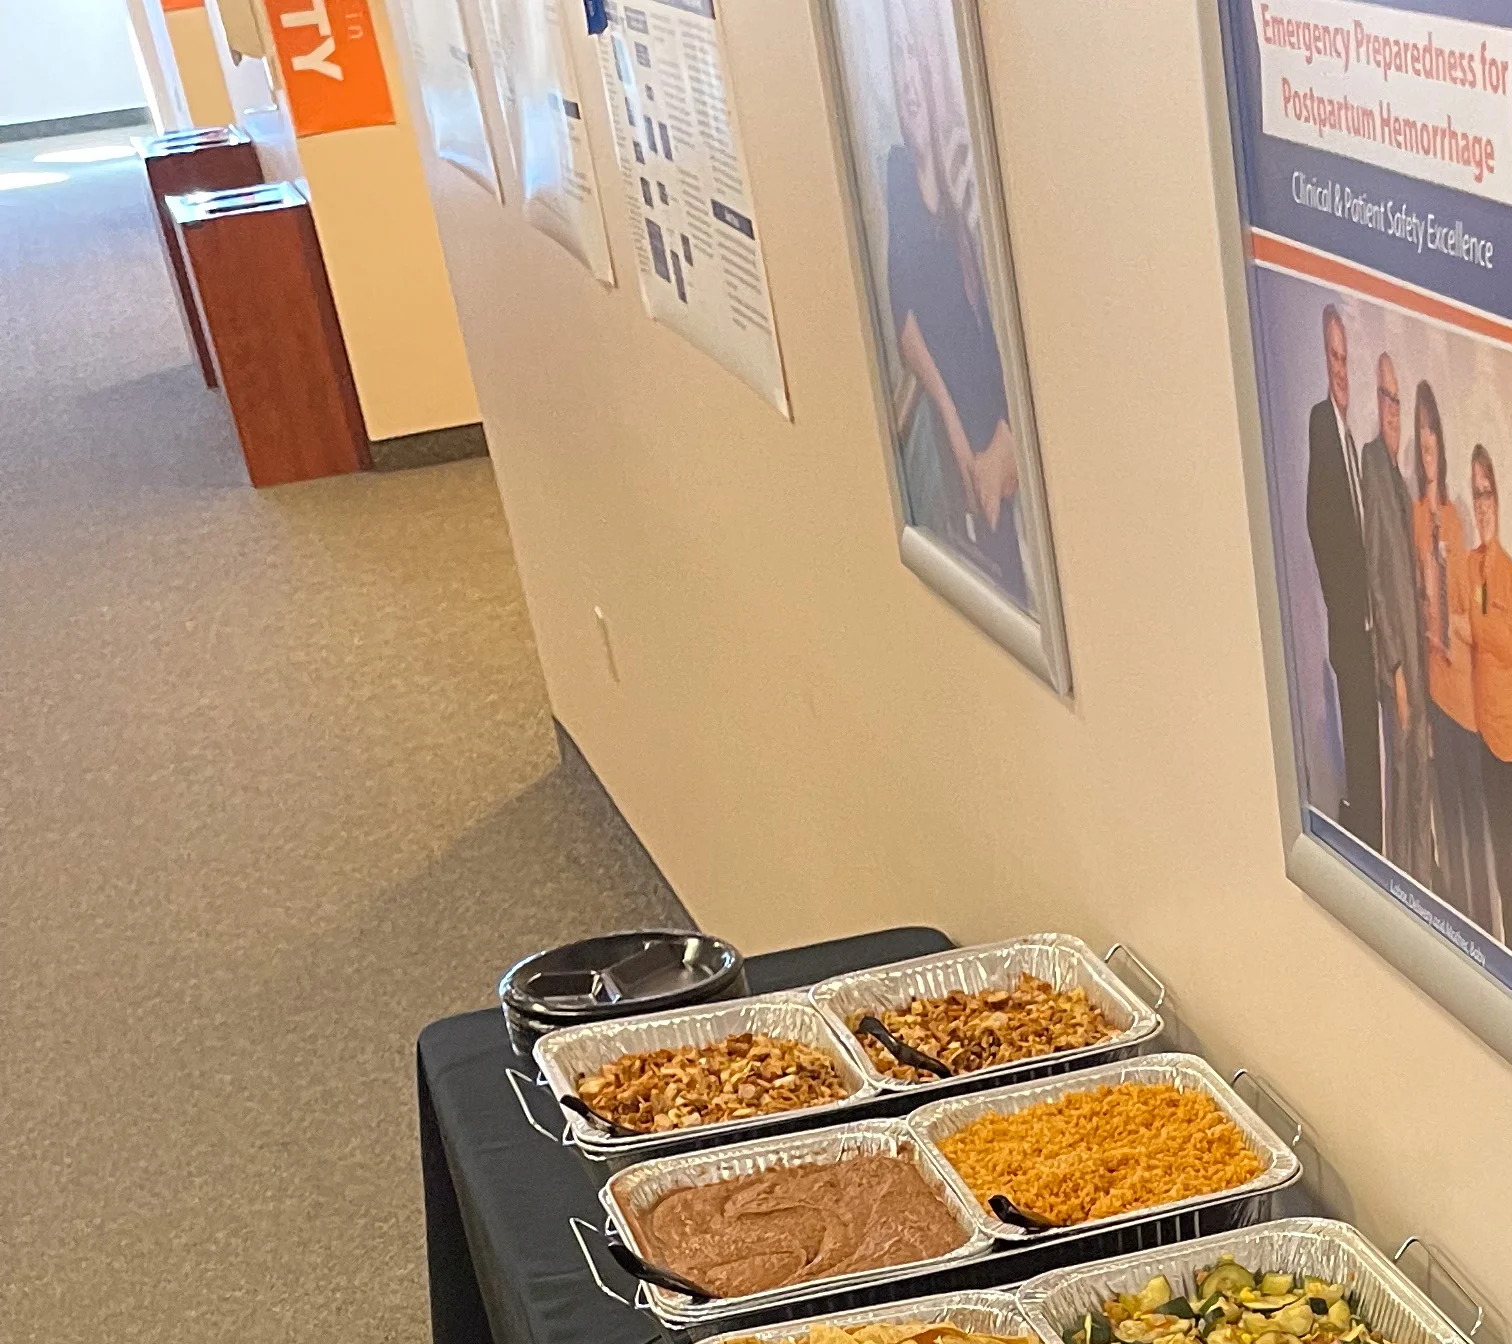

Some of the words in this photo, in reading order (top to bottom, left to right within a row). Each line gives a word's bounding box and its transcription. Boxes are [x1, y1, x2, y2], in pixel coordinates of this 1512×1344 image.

[1261, 4, 1350, 72] Emergency
[1354, 20, 1476, 89] Preparedness
[1481, 41, 1508, 95] for
[1282, 77, 1376, 141] Postpartum
[1380, 101, 1495, 183] Hemorrhage
[1292, 172, 1331, 212] Clinical
[1334, 184, 1342, 216] &
[1344, 187, 1385, 231] Patient
[1387, 201, 1425, 253] Safety
[1427, 214, 1493, 268] Excellence
